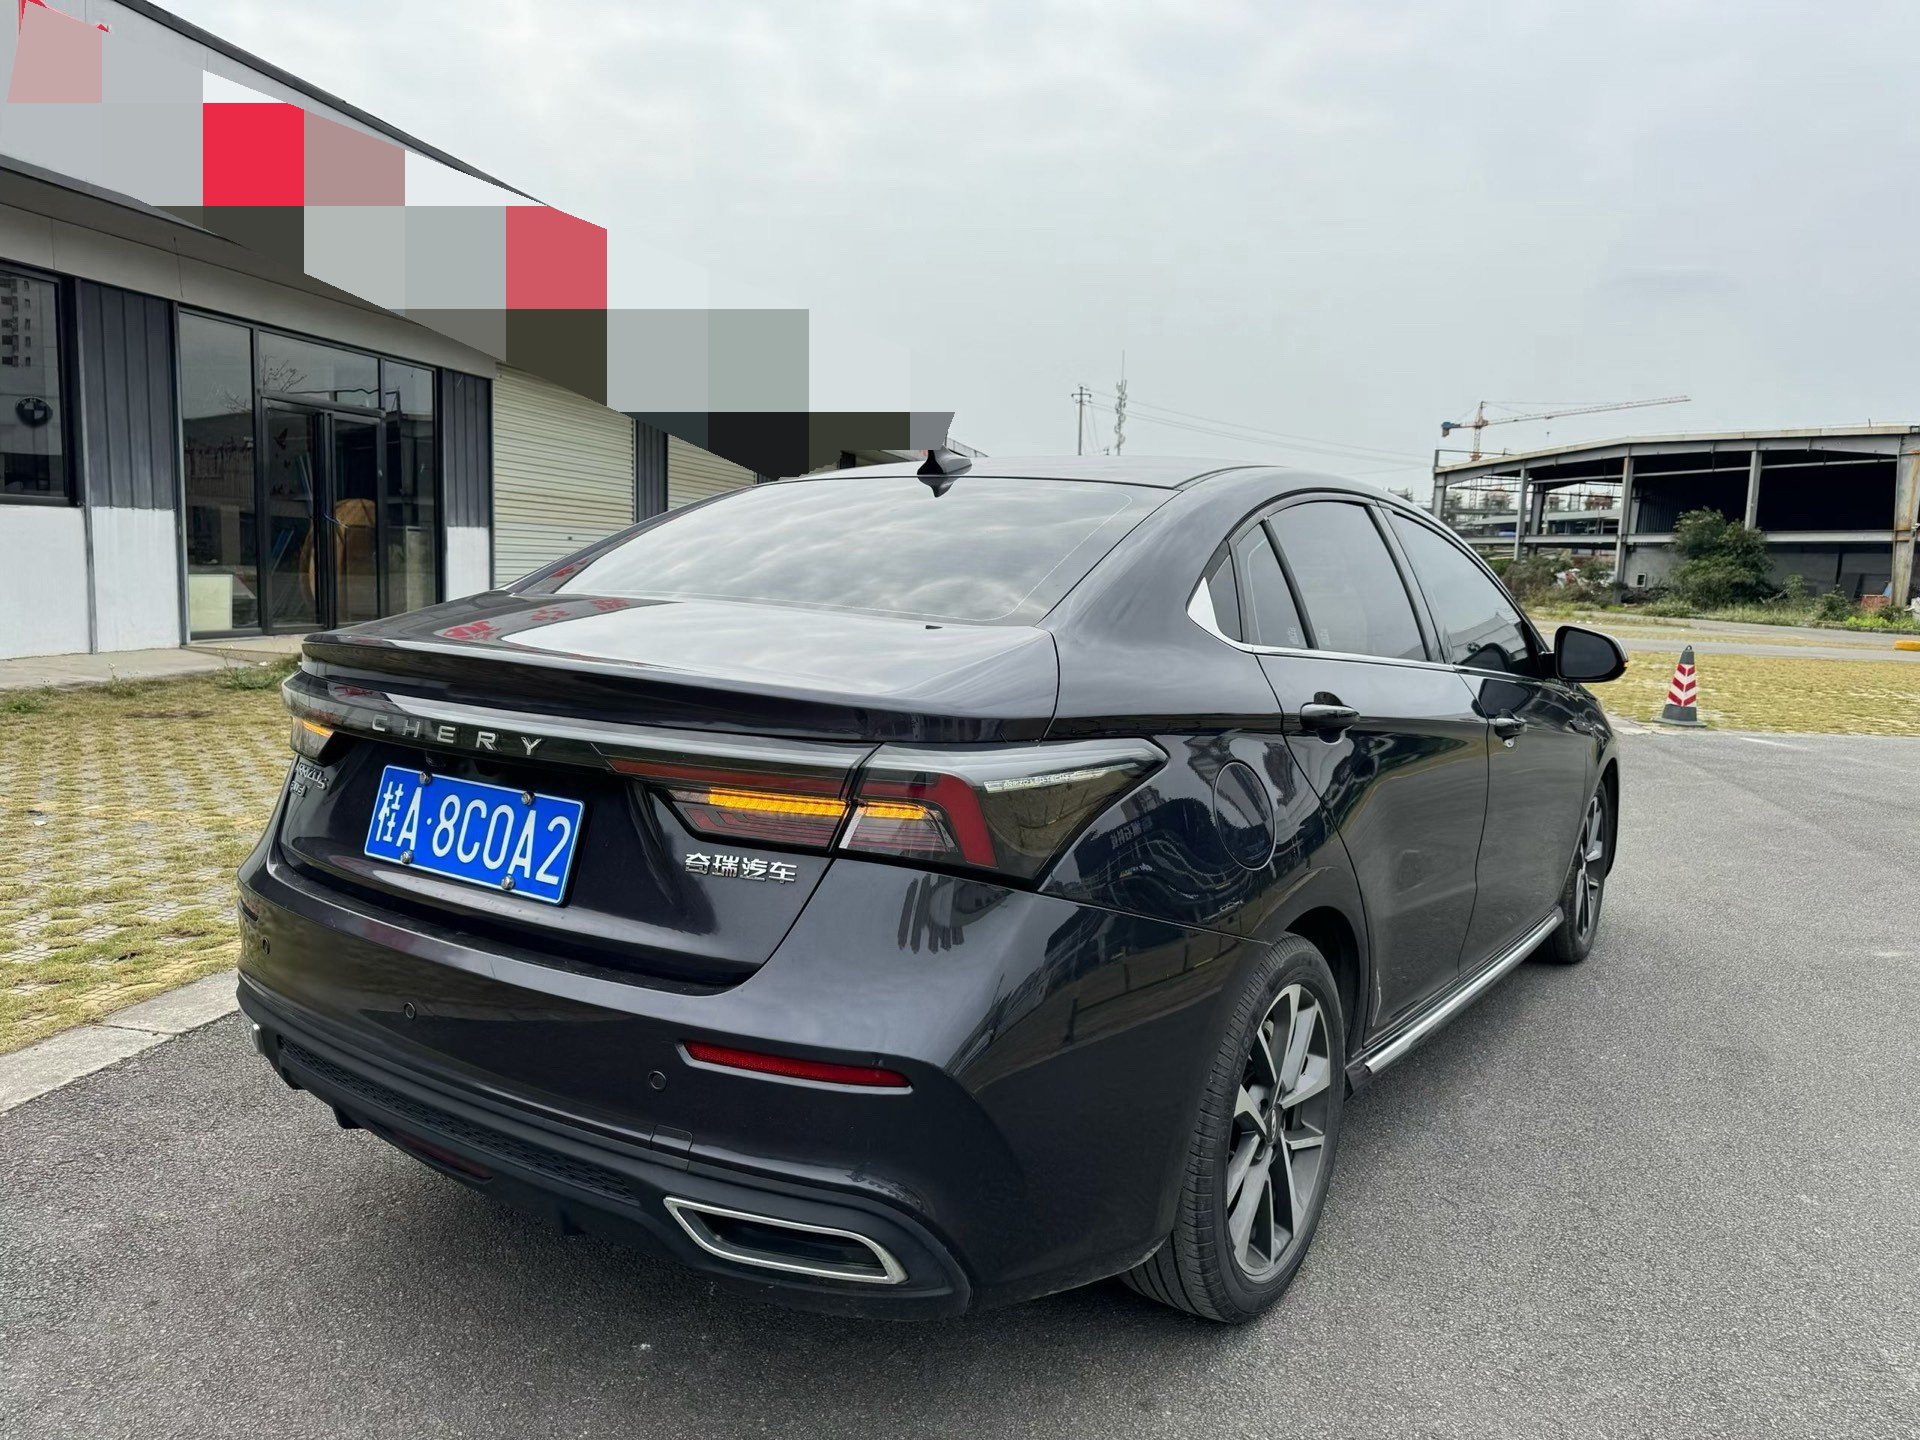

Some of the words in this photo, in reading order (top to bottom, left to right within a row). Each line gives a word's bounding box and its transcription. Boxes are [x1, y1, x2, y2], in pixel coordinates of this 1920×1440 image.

[372, 714, 542, 756] CHERY
[684, 852, 798, 884] 奇瑞汽车
